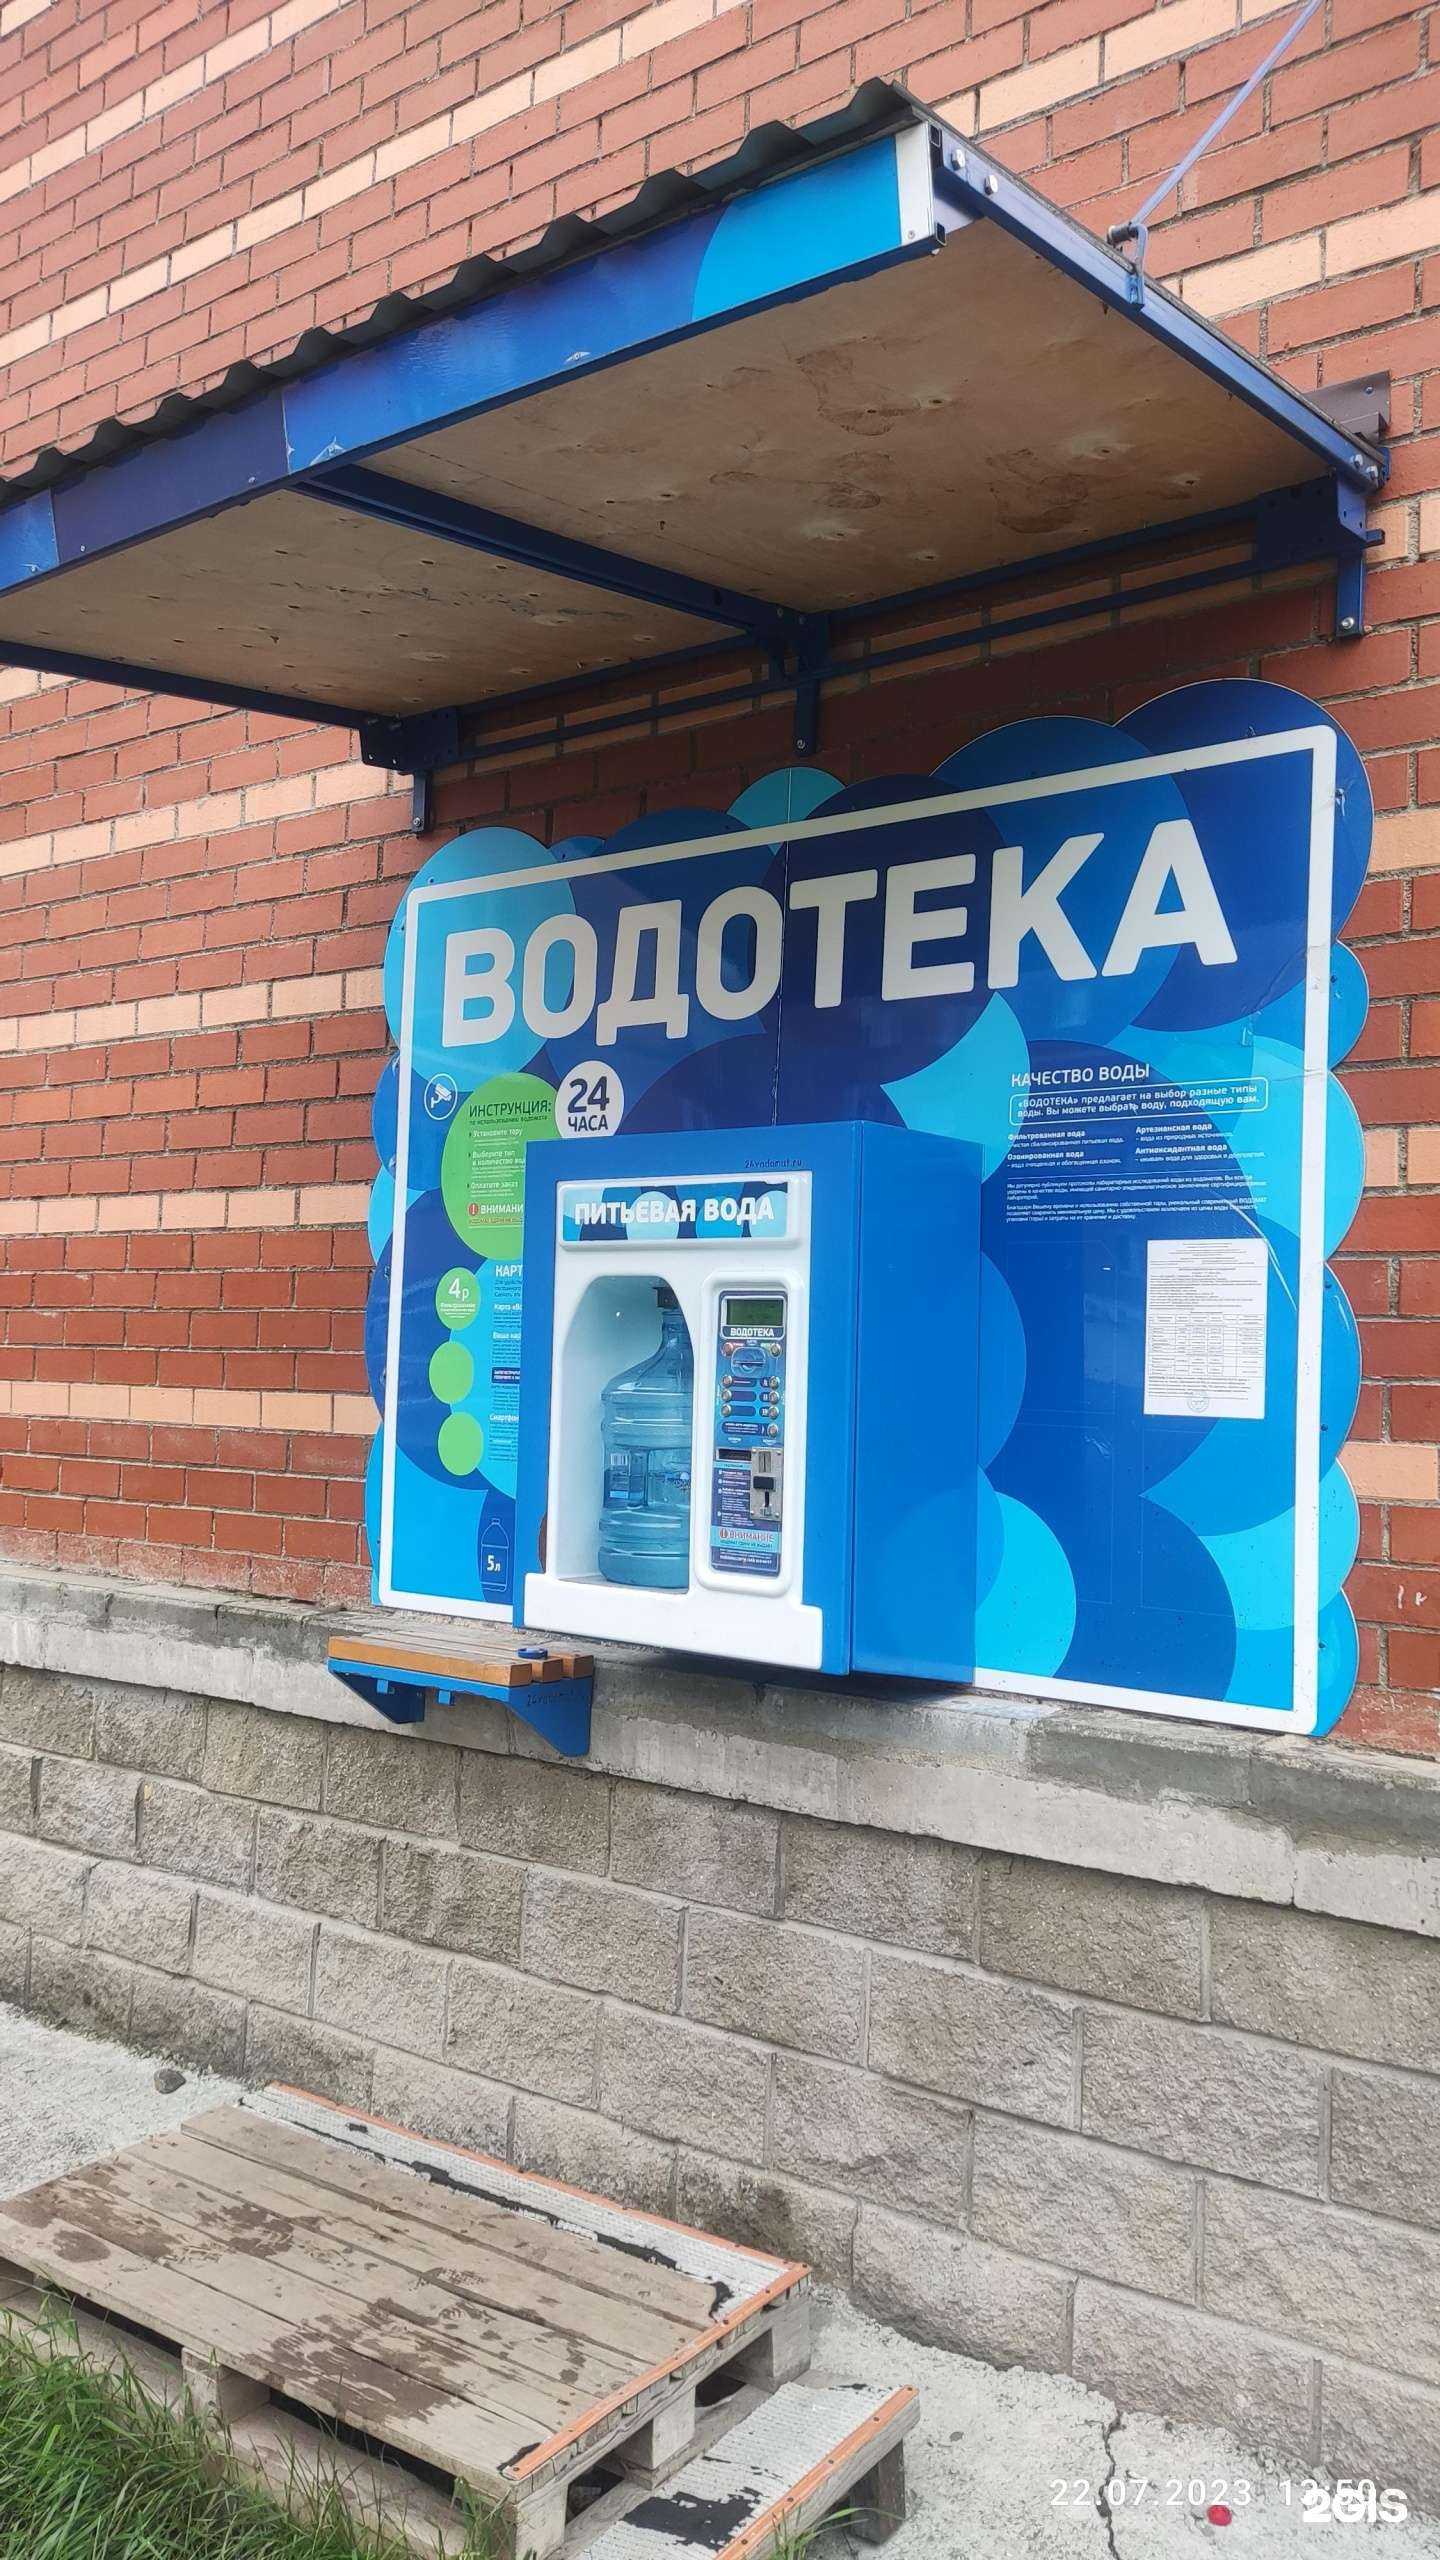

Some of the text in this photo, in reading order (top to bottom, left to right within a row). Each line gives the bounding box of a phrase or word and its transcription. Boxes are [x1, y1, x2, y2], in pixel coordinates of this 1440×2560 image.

[441, 818, 1238, 1047] ВОДОТЕКА
[1011, 1064, 1150, 1087] КАЧЕСТВО ВОДЫ
[567, 1076, 610, 1113] 24
[1018, 1096, 1078, 1108] «ВОДОТЕКА»
[1082, 1093, 1137, 1104] предлагает
[1154, 1089, 1187, 1099] выбор
[1189, 1087, 1228, 1098] разные
[1231, 1085, 1257, 1093] типы
[469, 1100, 552, 1117] ИНСТРУКЦИЯ:
[1018, 1109, 1045, 1118] воды.
[1046, 1107, 1060, 1115] Вы
[1062, 1105, 1097, 1114] можете
[1099, 1102, 1139, 1113] выбрать
[1169, 1096, 1234, 1109] подходящую
[568, 1114, 609, 1132] ЧАСА
[480, 1203, 524, 1215] ВНИМАНИ
[574, 1196, 776, 1226] ПИТЬЕВАЯ ВОДА
[495, 1264, 523, 1278] КАРТ
[730, 1328, 775, 1338] ВОДОТЕКА
[486, 1554, 501, 1572] 5л
